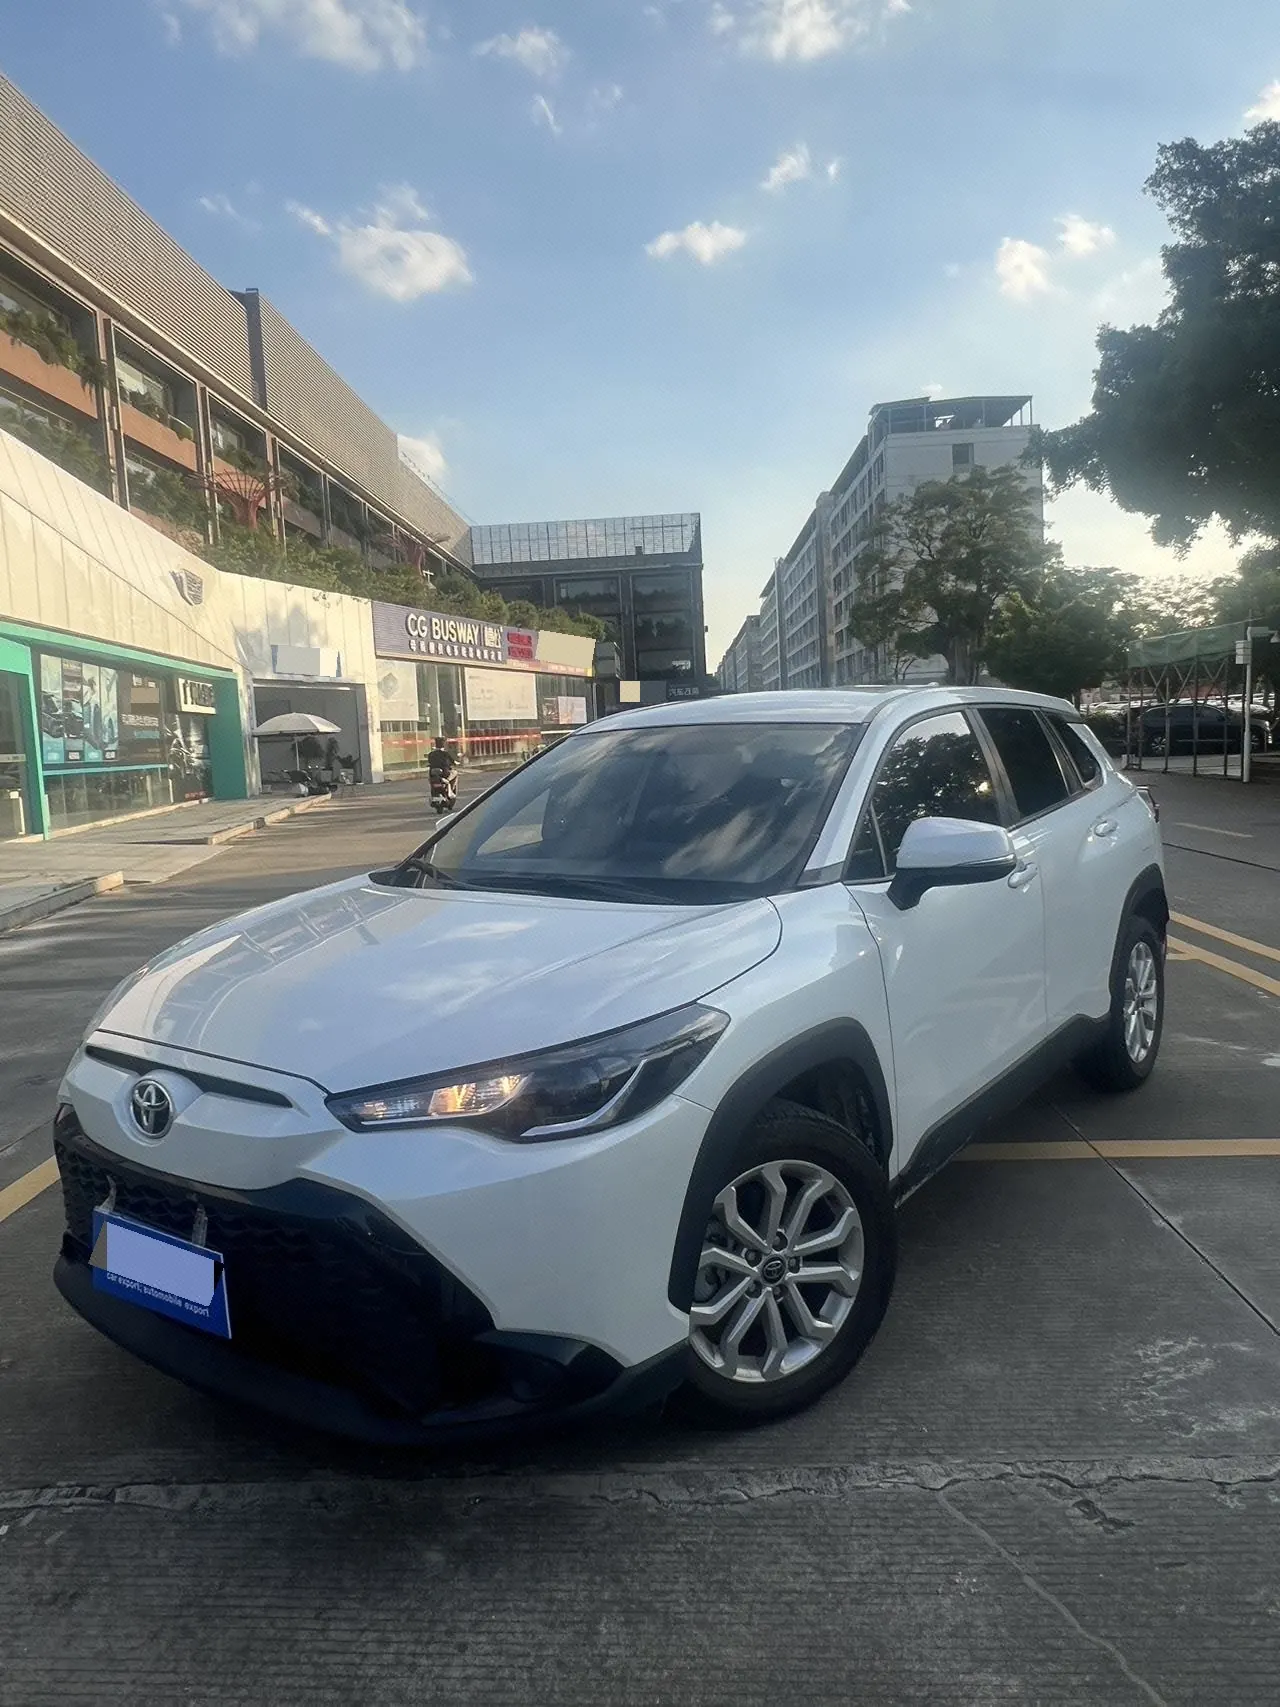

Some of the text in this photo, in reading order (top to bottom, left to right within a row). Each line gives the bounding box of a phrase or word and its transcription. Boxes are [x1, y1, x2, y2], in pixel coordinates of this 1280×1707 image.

[407, 613, 428, 637] CG
[431, 618, 479, 645] BUSWAY
[143, 1286, 183, 1307] automobile
[184, 1302, 210, 1317] export
